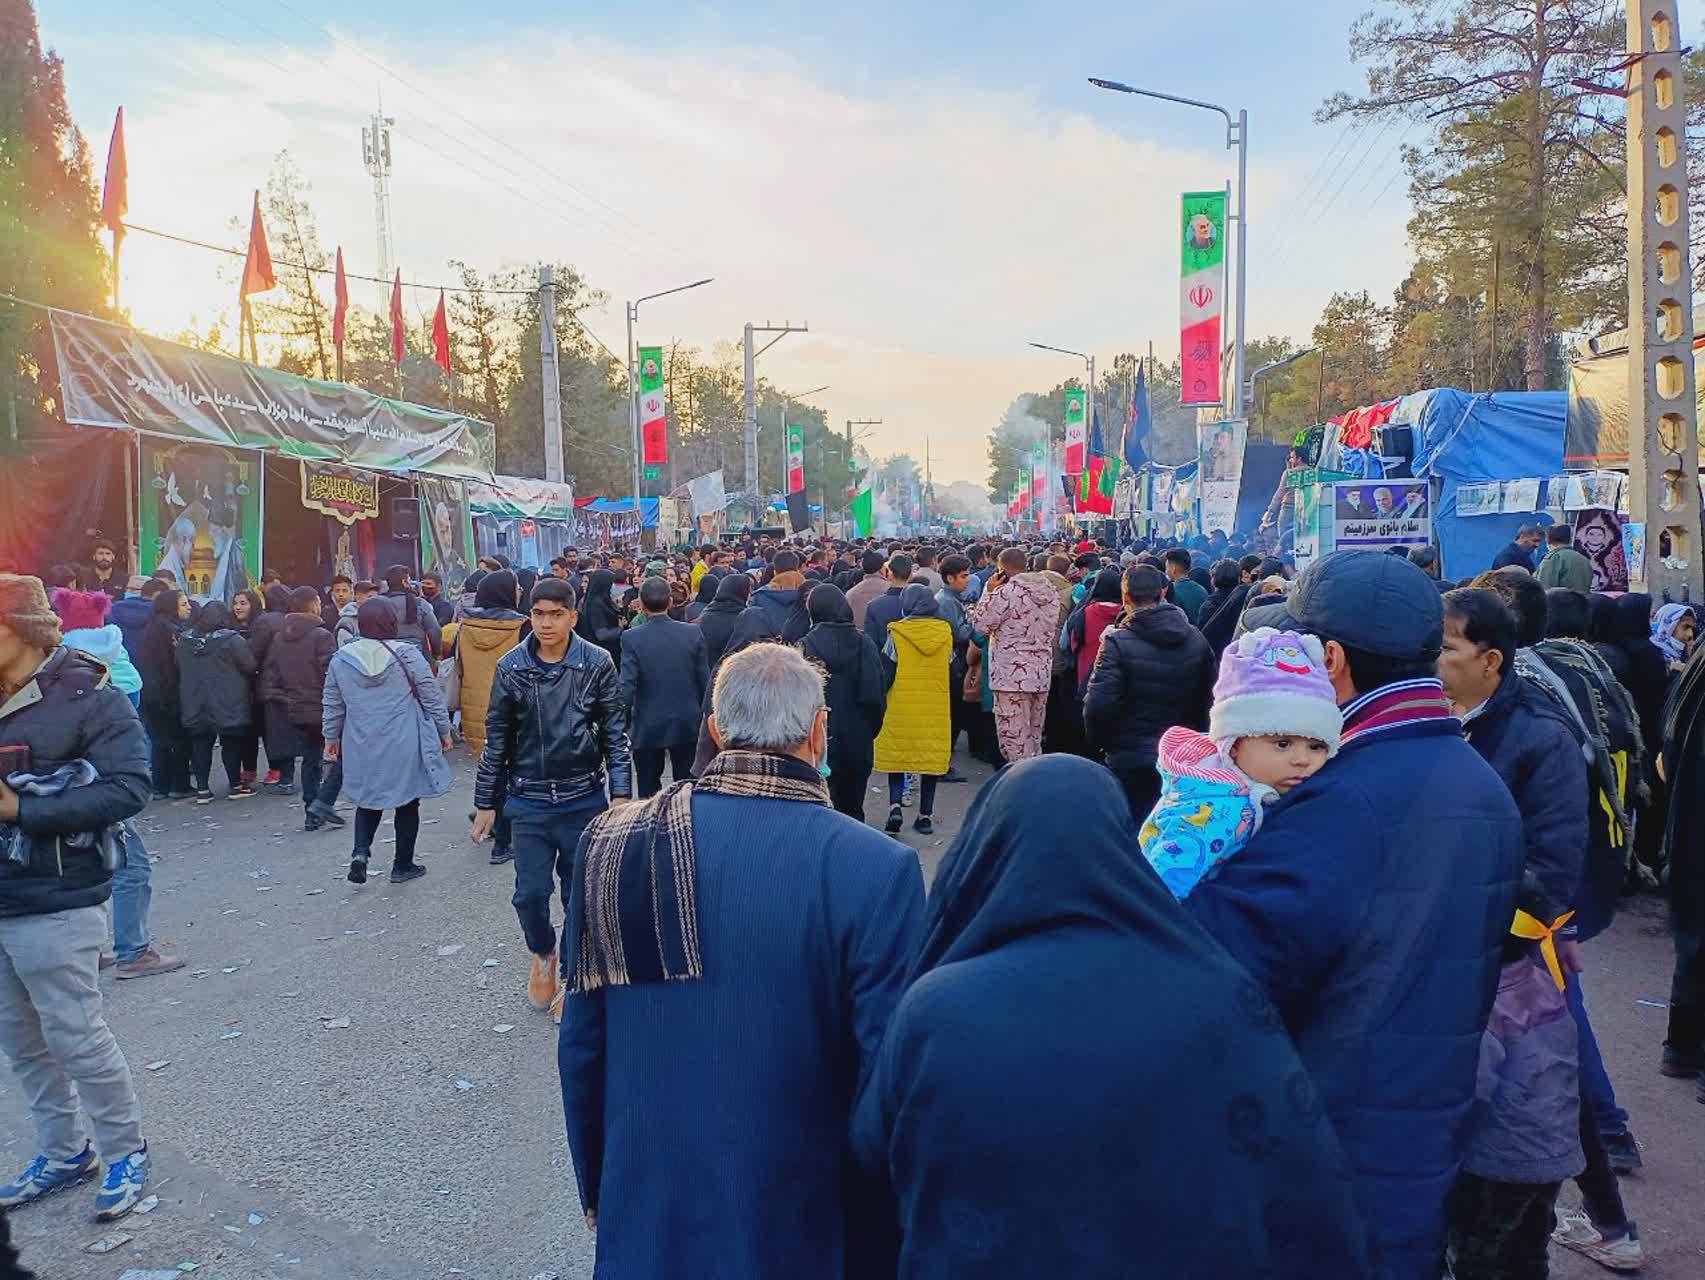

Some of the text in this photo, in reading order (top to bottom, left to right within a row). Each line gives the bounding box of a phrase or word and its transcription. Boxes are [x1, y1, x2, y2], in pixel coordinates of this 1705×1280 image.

[191, 388, 231, 411] عباس
[231, 398, 258, 415] سید
[1343, 520, 1419, 536] سلام بانوی سرزمینم
